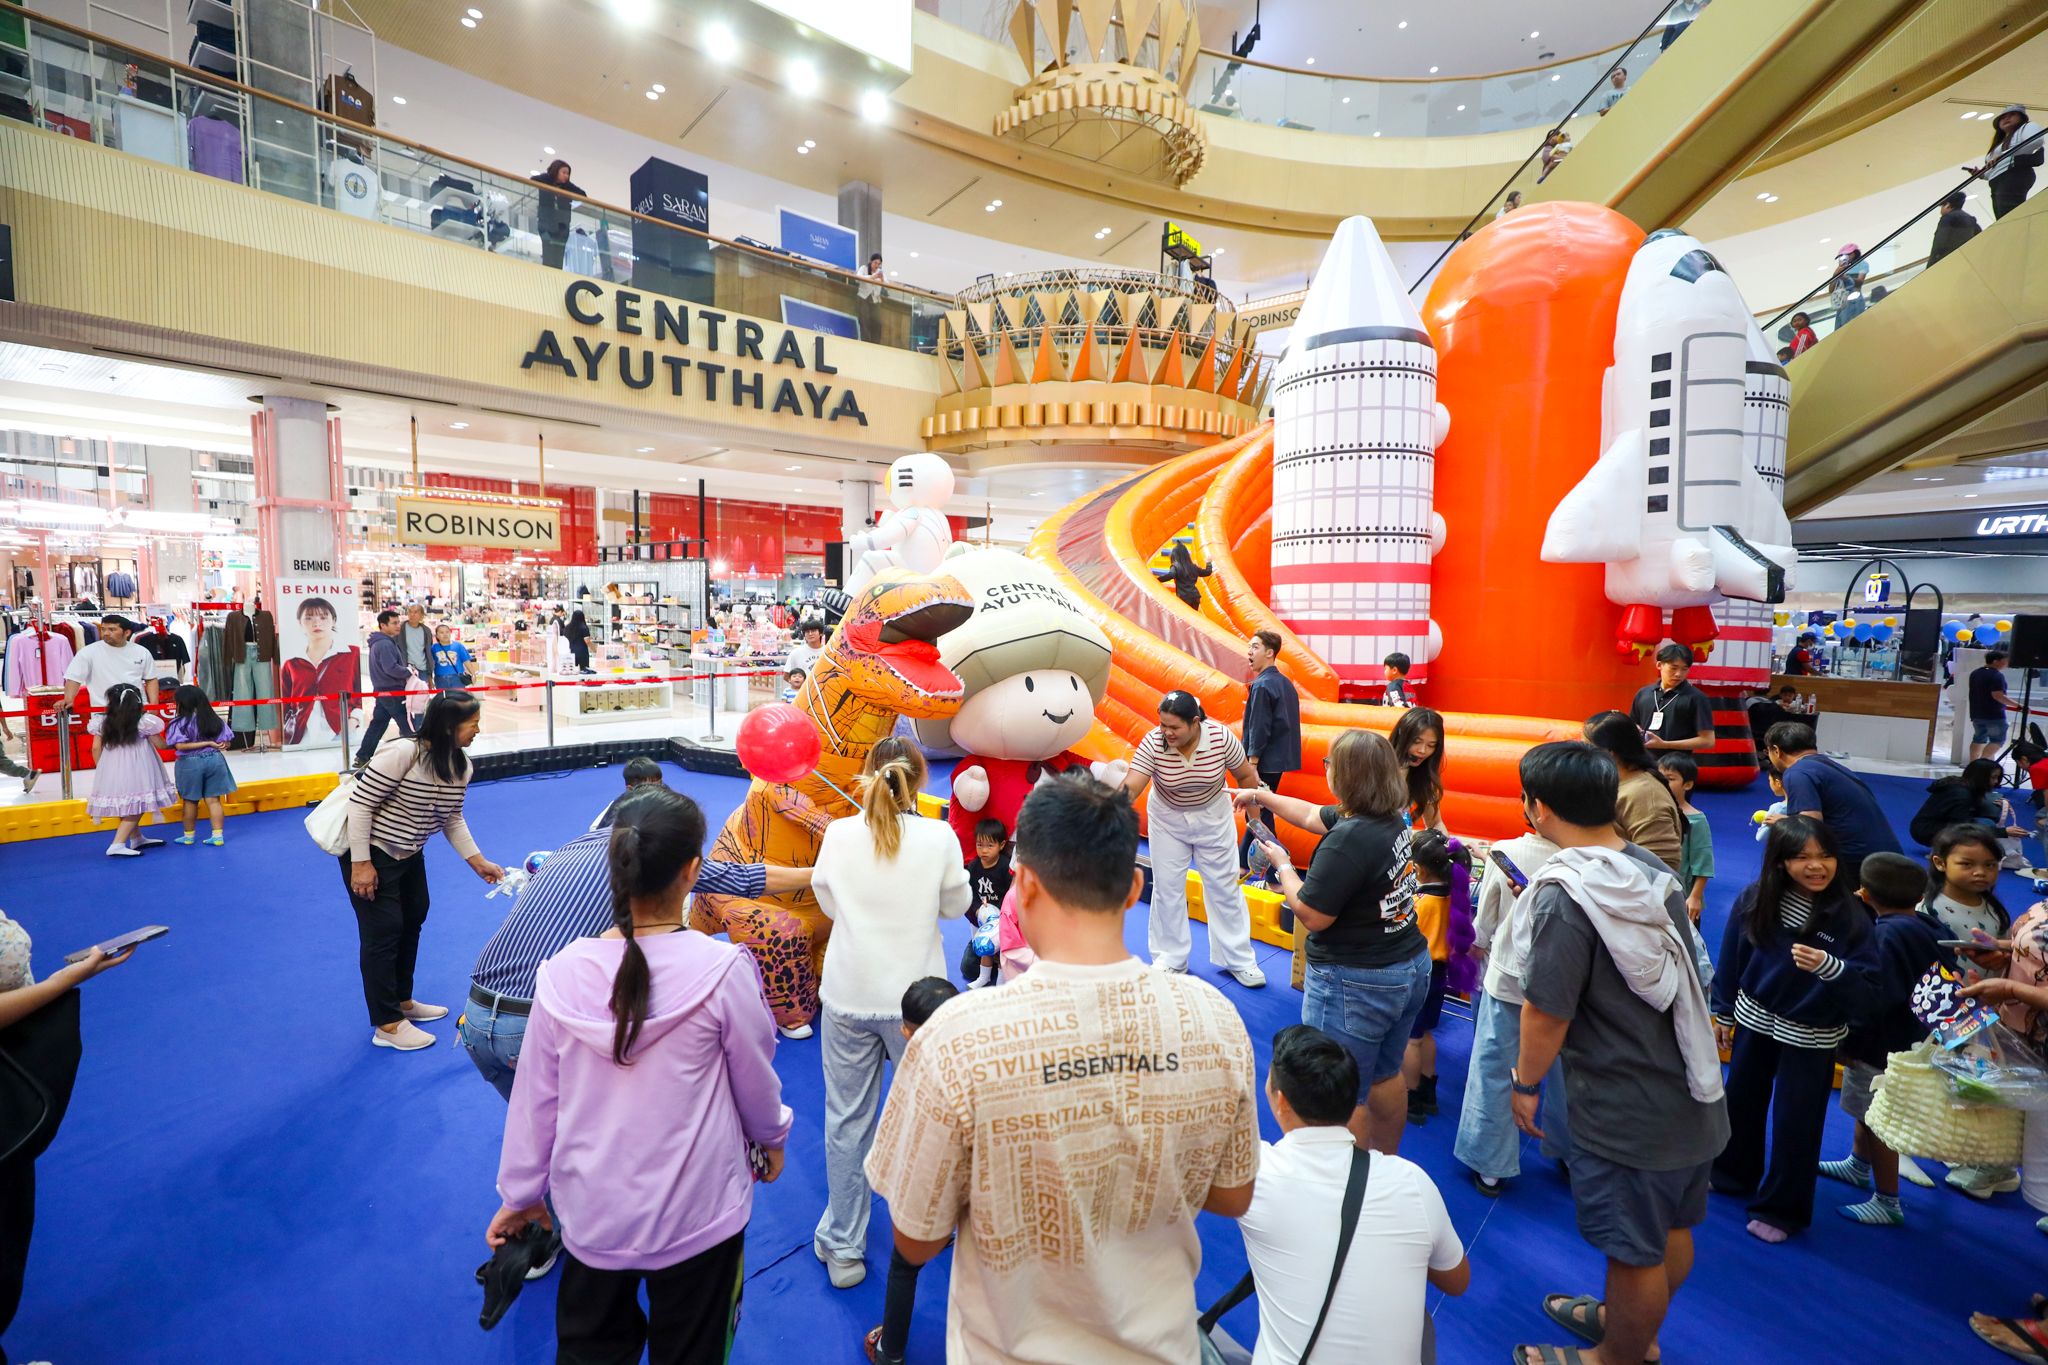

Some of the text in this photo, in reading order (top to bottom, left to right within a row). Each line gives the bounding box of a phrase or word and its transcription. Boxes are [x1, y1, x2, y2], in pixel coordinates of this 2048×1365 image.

[341, 89, 363, 110] Lee
[663, 193, 707, 221] SARAN
[565, 279, 838, 375] CENTRAL
[1241, 306, 1301, 329] OBINSO
[520, 329, 869, 427] AYUTTHAYA
[406, 511, 553, 540] ROBINSON
[293, 559, 331, 572] BEMING
[282, 585, 353, 595] BEMING
[980, 592, 1084, 616] AYUTTHAYA
[986, 582, 1067, 601] CENTRAL
[951, 1013, 1079, 1055] ESSENTIALS
[1043, 1053, 1179, 1084] ESSENTIALS
[991, 1100, 1114, 1134] ESSENTIALS
[1141, 1101, 1236, 1125] ESSENTIALS
[1018, 1143, 1037, 1224] ESSENTIALS
